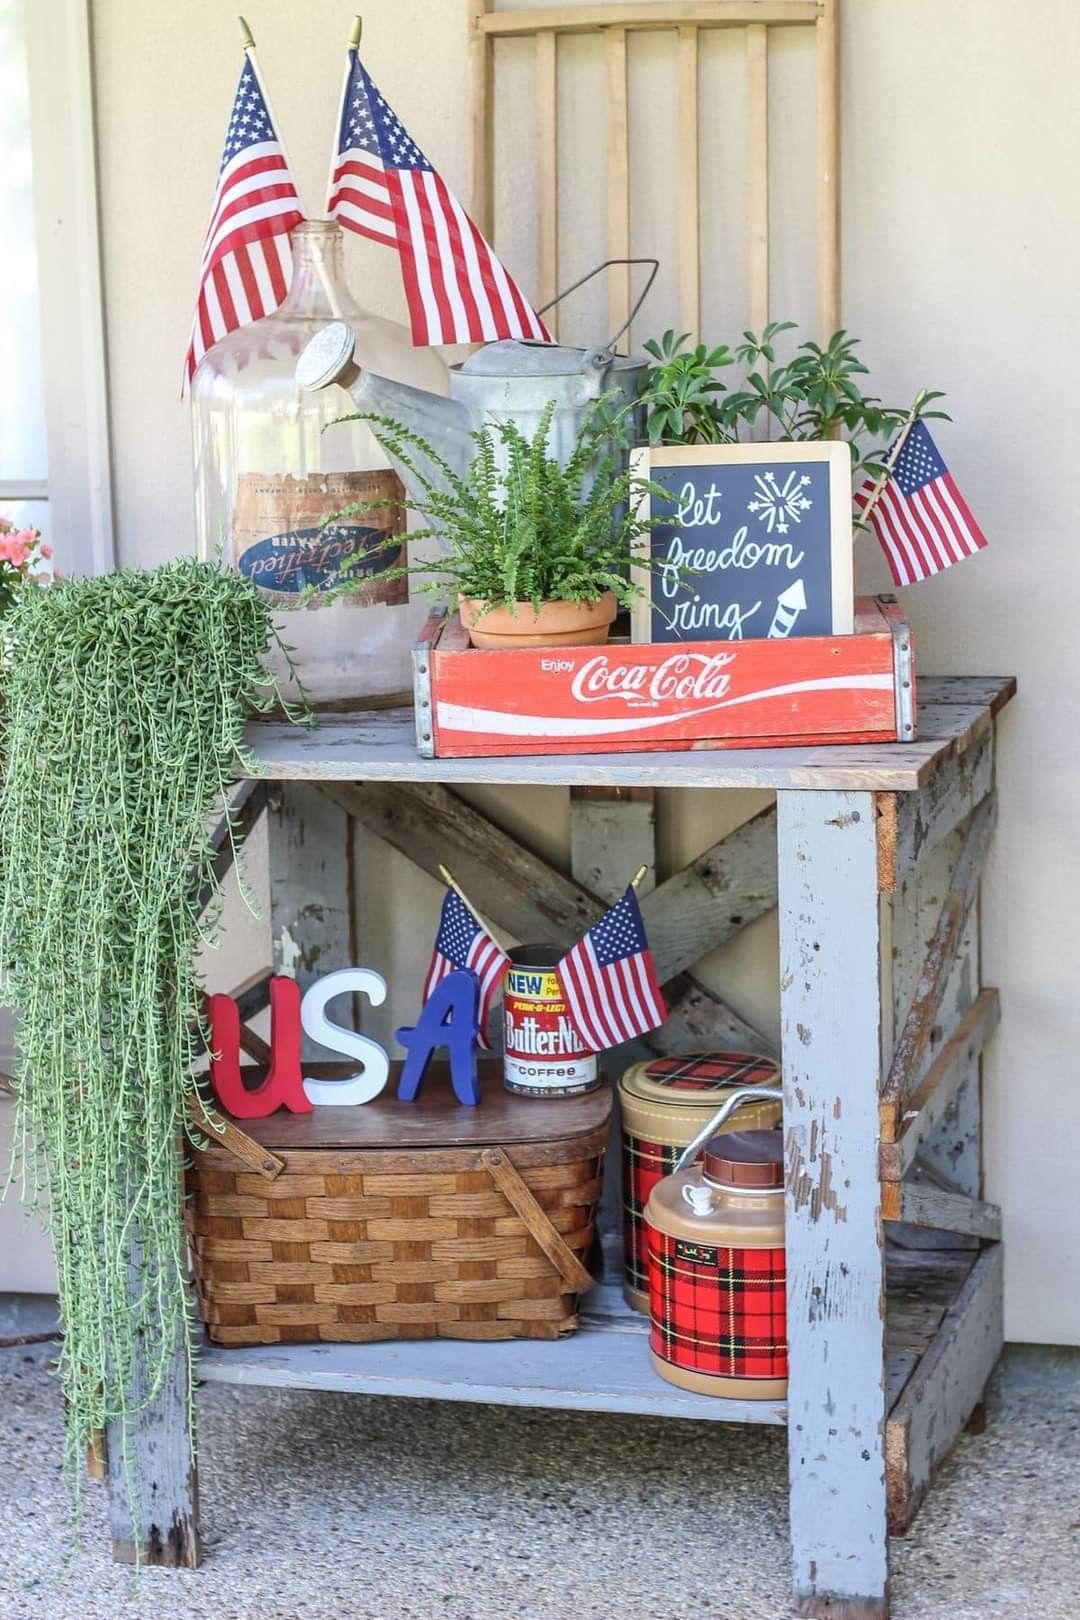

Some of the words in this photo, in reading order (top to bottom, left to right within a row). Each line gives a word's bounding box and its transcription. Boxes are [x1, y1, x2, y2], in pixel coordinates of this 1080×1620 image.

[674, 482, 722, 527] let
[658, 526, 804, 598] freedom
[666, 595, 762, 640] ring
[541, 659, 575, 673] Enjoy
[571, 652, 736, 702] Coca-Cola
[508, 972, 543, 995] NEW
[208, 967, 481, 1119] USA
[506, 1011, 585, 1055] Butter-Nu
